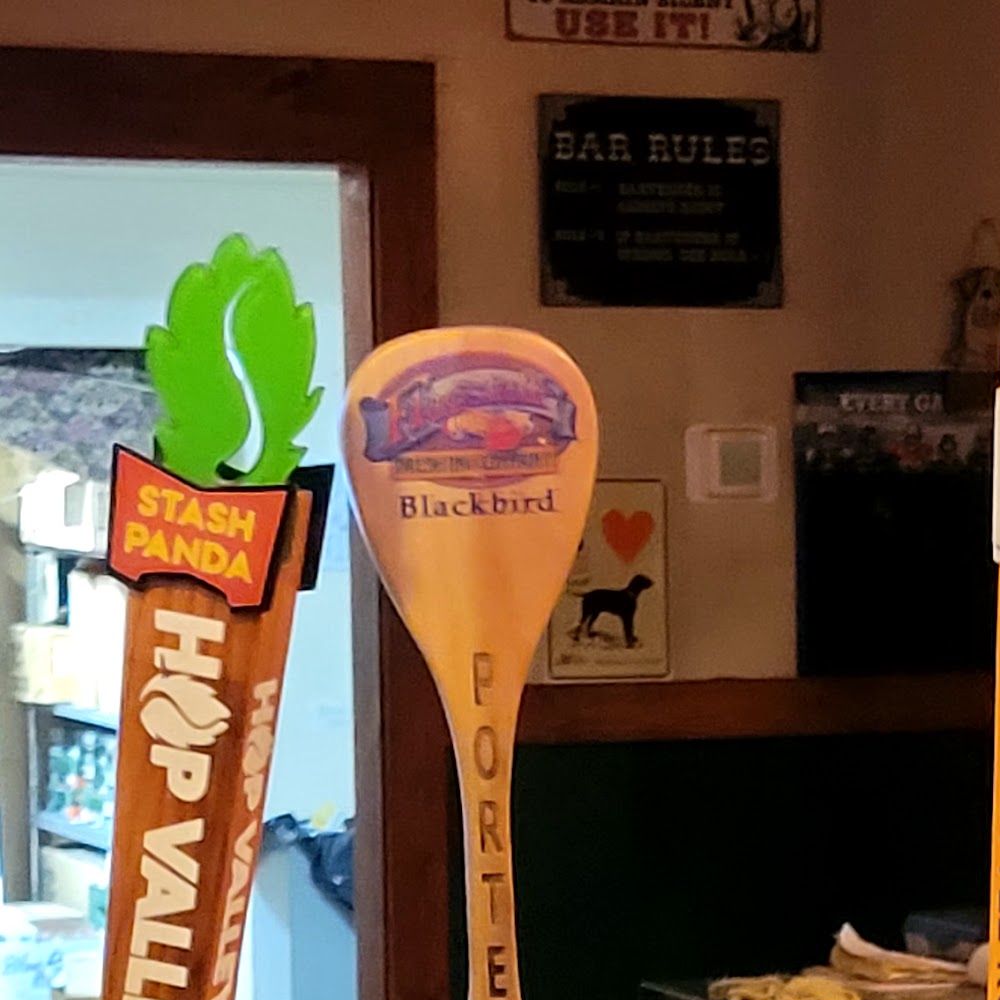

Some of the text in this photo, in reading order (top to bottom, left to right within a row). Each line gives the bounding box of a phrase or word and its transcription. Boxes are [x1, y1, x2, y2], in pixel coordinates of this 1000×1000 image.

[555, 8, 711, 40] USE IT!
[554, 132, 771, 164] BAR RULES
[137, 484, 256, 543] STASH
[400, 488, 559, 519] Blackbird
[124, 521, 253, 584] PANDA
